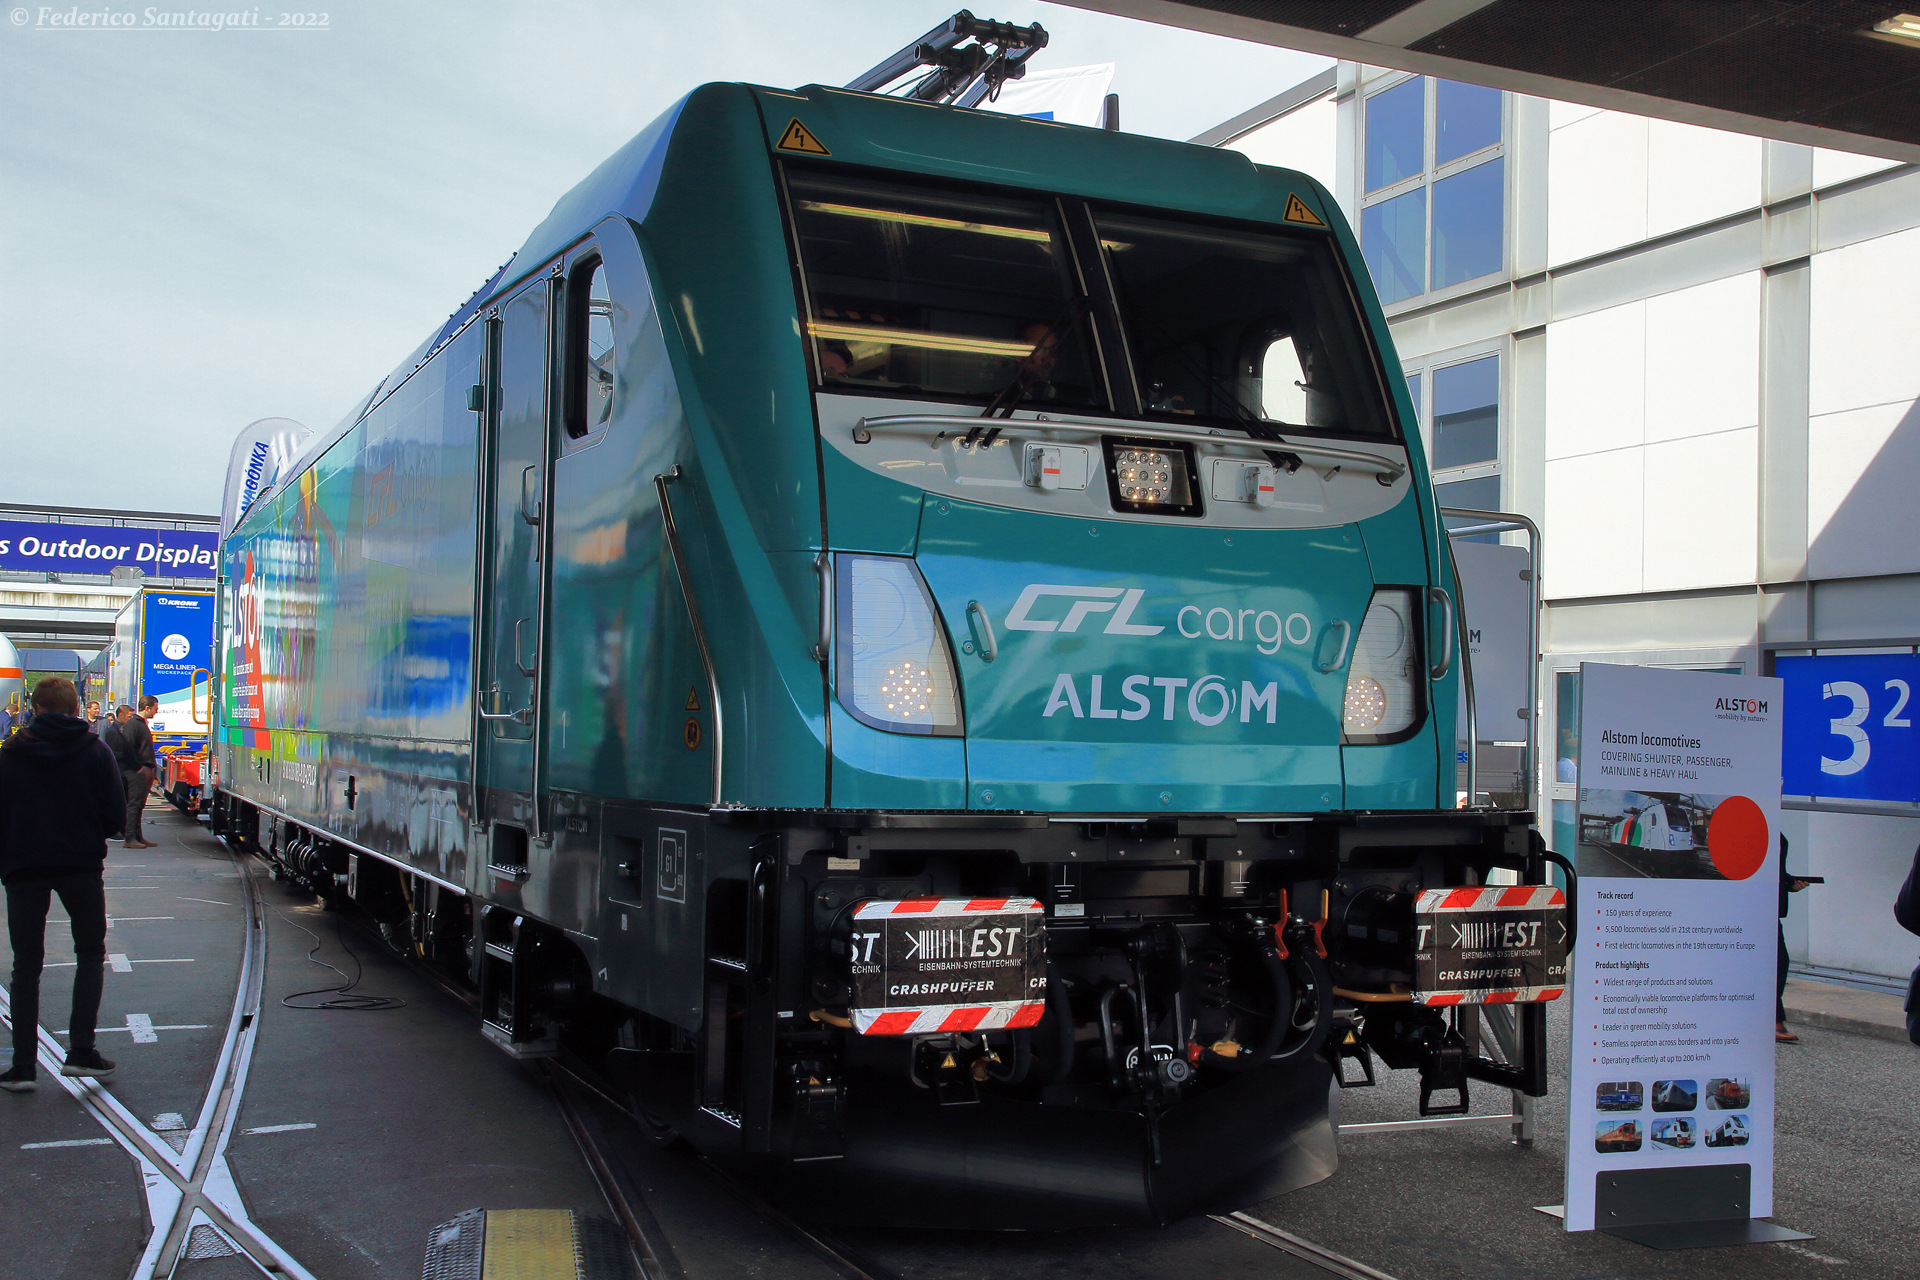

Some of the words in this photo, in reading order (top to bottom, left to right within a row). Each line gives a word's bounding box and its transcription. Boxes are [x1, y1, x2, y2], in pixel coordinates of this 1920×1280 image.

[367, 461, 399, 527] CFL
[400, 451, 436, 514] cargo
[18, 536, 130, 561] Outdoor
[136, 542, 220, 570] Display
[229, 572, 266, 649] ALSTOM
[1004, 583, 1166, 636] CFL
[1176, 605, 1311, 655] cargo
[1042, 673, 1278, 727] ALSTOM
[1715, 697, 1768, 713] ALSTOM
[1718, 713, 1740, 722] mobility
[1740, 714, 1747, 722] by
[1601, 730, 1638, 745] Alstom
[1641, 731, 1701, 749] locomotives
[1601, 751, 1642, 763] COVERING
[1644, 753, 1684, 766] SHUNTER,
[1686, 756, 1734, 769] PASSENGER,
[1600, 766, 1641, 777] MAINLINE
[1642, 768, 1648, 778] &
[1650, 768, 1676, 780] HEAVY
[1678, 770, 1699, 780] HAUL
[1597, 891, 1613, 900] Track
[1614, 892, 1634, 900] record
[1606, 909, 1617, 917] 150
[1618, 910, 1634, 918] years
[1634, 909, 1641, 917] of
[1642, 910, 1672, 918] experience
[1502, 921, 1542, 948] EST
[1605, 925, 1622, 934] 5,500
[1624, 925, 1657, 934] locomotives
[1658, 925, 1670, 933] sold
[1678, 926, 1690, 934] 21st
[1692, 926, 1713, 935] century
[1714, 926, 1743, 934] worldwide
[970, 927, 1021, 958] EST
[1605, 941, 1618, 949] First
[1619, 941, 1640, 950] electric
[1641, 941, 1674, 950] locomotives
[1675, 942, 1681, 950] in
[1682, 942, 1692, 950] the
[1693, 942, 1706, 950] 19th
[1708, 942, 1728, 951] century
[1729, 942, 1735, 950] in
[1736, 942, 1755, 950] Europe
[1462, 949, 1542, 960] EISENBAHN-SYSTEMTECHNIK
[919, 958, 1022, 972] EISENBAHN-SYSTEMTECHNIK
[1595, 961, 1619, 969] Product
[1620, 961, 1649, 970] highlights
[1438, 968, 1522, 981] CRASHPUFFER
[890, 980, 995, 996] CRASHPUFFER
[1603, 978, 1624, 986] Widest
[1625, 979, 1642, 987] range
[1643, 978, 1650, 986] of
[1650, 978, 1675, 987] products
[1676, 978, 1687, 986] and
[1688, 978, 1713, 986] solutions
[1603, 994, 1641, 1003] Economically
[1642, 994, 1659, 1002] viable
[1660, 994, 1690, 1002] locomotive
[1691, 994, 1718, 1003] platforms
[1728, 993, 1755, 1002] optimised
[1602, 1006, 1616, 1015] total
[1617, 1007, 1629, 1015] cost
[1630, 1006, 1637, 1014] of
[1638, 1006, 1667, 1015] ownership
[1602, 1023, 1622, 1032] Leader
[1623, 1022, 1629, 1031] in
[1630, 1024, 1646, 1032] green
[1648, 1022, 1670, 1032] mobility
[1672, 1021, 1697, 1030] solutions
[1602, 1039, 1629, 1048] Seamless
[1630, 1039, 1657, 1048] operation
[1678, 1038, 1699, 1046] borders
[1712, 1037, 1723, 1045] into
[1724, 1037, 1739, 1046] yards
[1601, 1056, 1630, 1065] Operating
[1631, 1055, 1658, 1064] efficiently
[1683, 1054, 1694, 1062] 200
[1695, 1054, 1711, 1062] km/h
